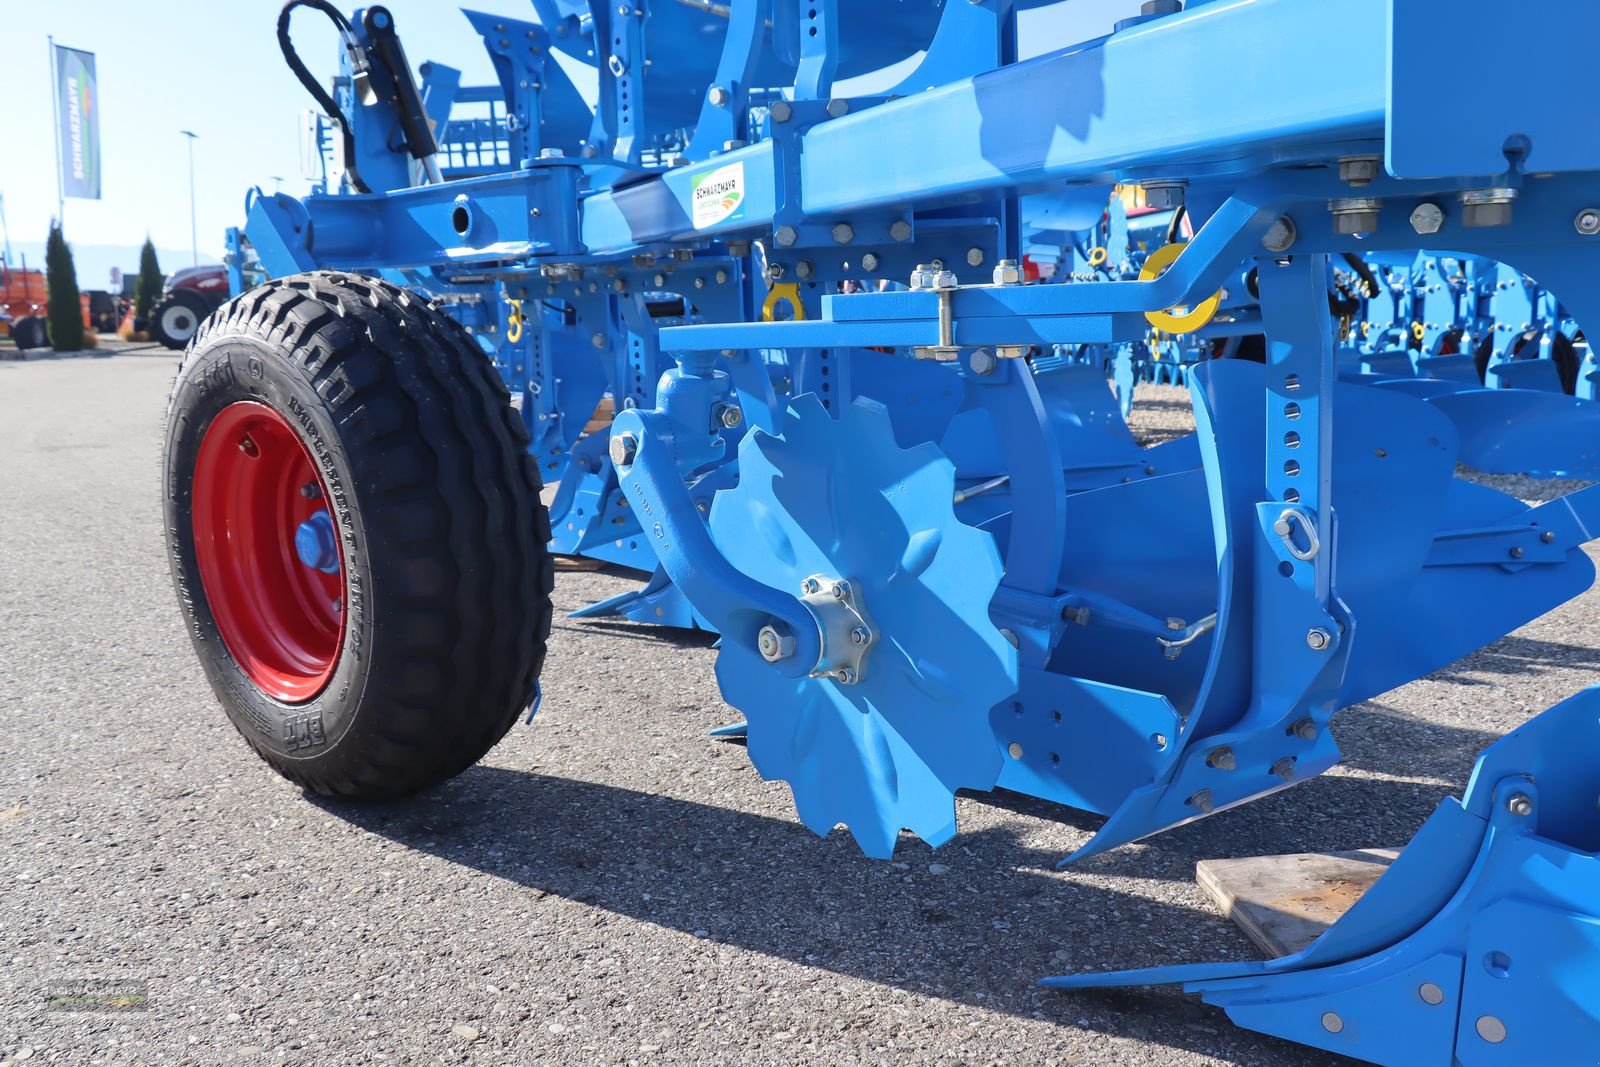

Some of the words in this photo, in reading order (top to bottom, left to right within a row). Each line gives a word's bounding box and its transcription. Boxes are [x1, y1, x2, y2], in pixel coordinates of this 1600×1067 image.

[67, 77, 84, 179] SCHWARZMAYR
[696, 179, 736, 199] SCHWARZMAYR
[288, 395, 358, 550] IMPLEMENT
